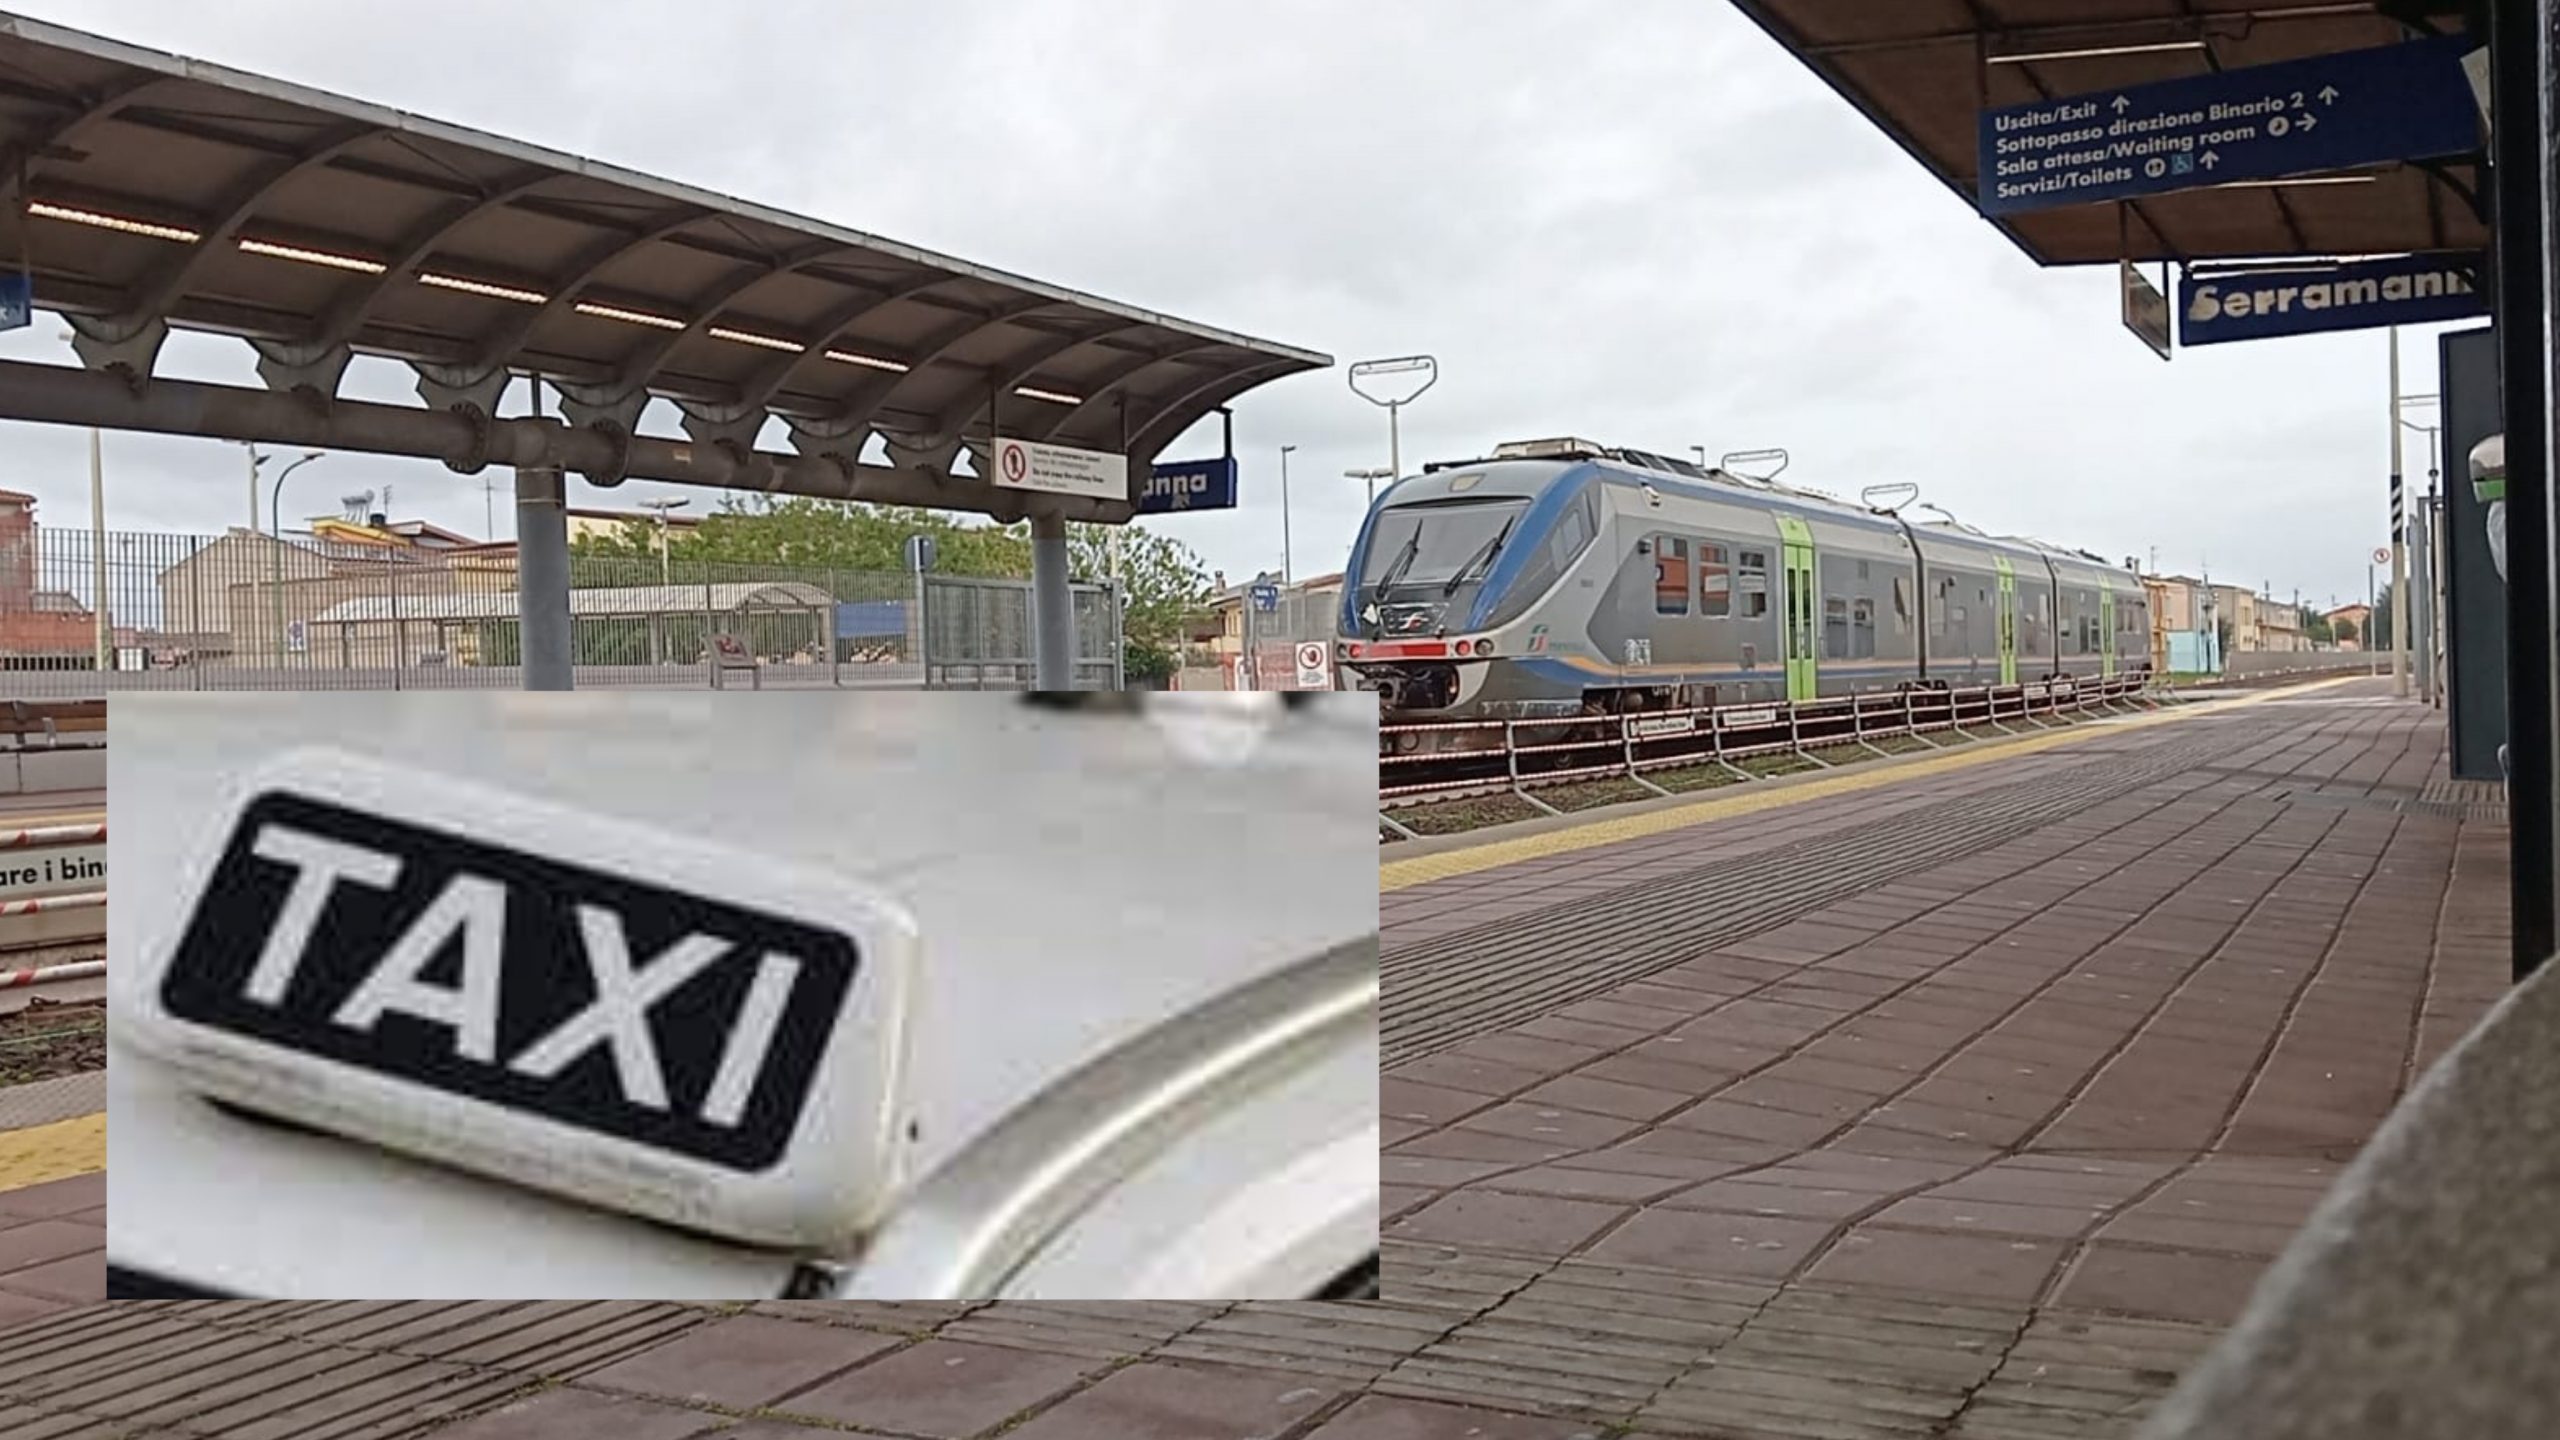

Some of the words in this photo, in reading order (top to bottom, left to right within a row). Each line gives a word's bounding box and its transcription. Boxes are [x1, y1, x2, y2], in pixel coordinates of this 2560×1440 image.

[1995, 102, 2098, 132] Uscita/Exit
[1996, 127, 2103, 154] Sottopasso
[2108, 112, 2204, 137] direzione
[2208, 96, 2285, 121] Binario
[2290, 91, 2305, 108] 2
[1996, 156, 2039, 176] Sala
[2043, 134, 2194, 169] attesa/Waiting
[2199, 126, 2256, 146] room
[1996, 166, 2133, 199] Servizi/Toilets
[45, 860, 52, 882] i
[60, 856, 107, 880] bin
[243, 823, 802, 1128] TAXI
